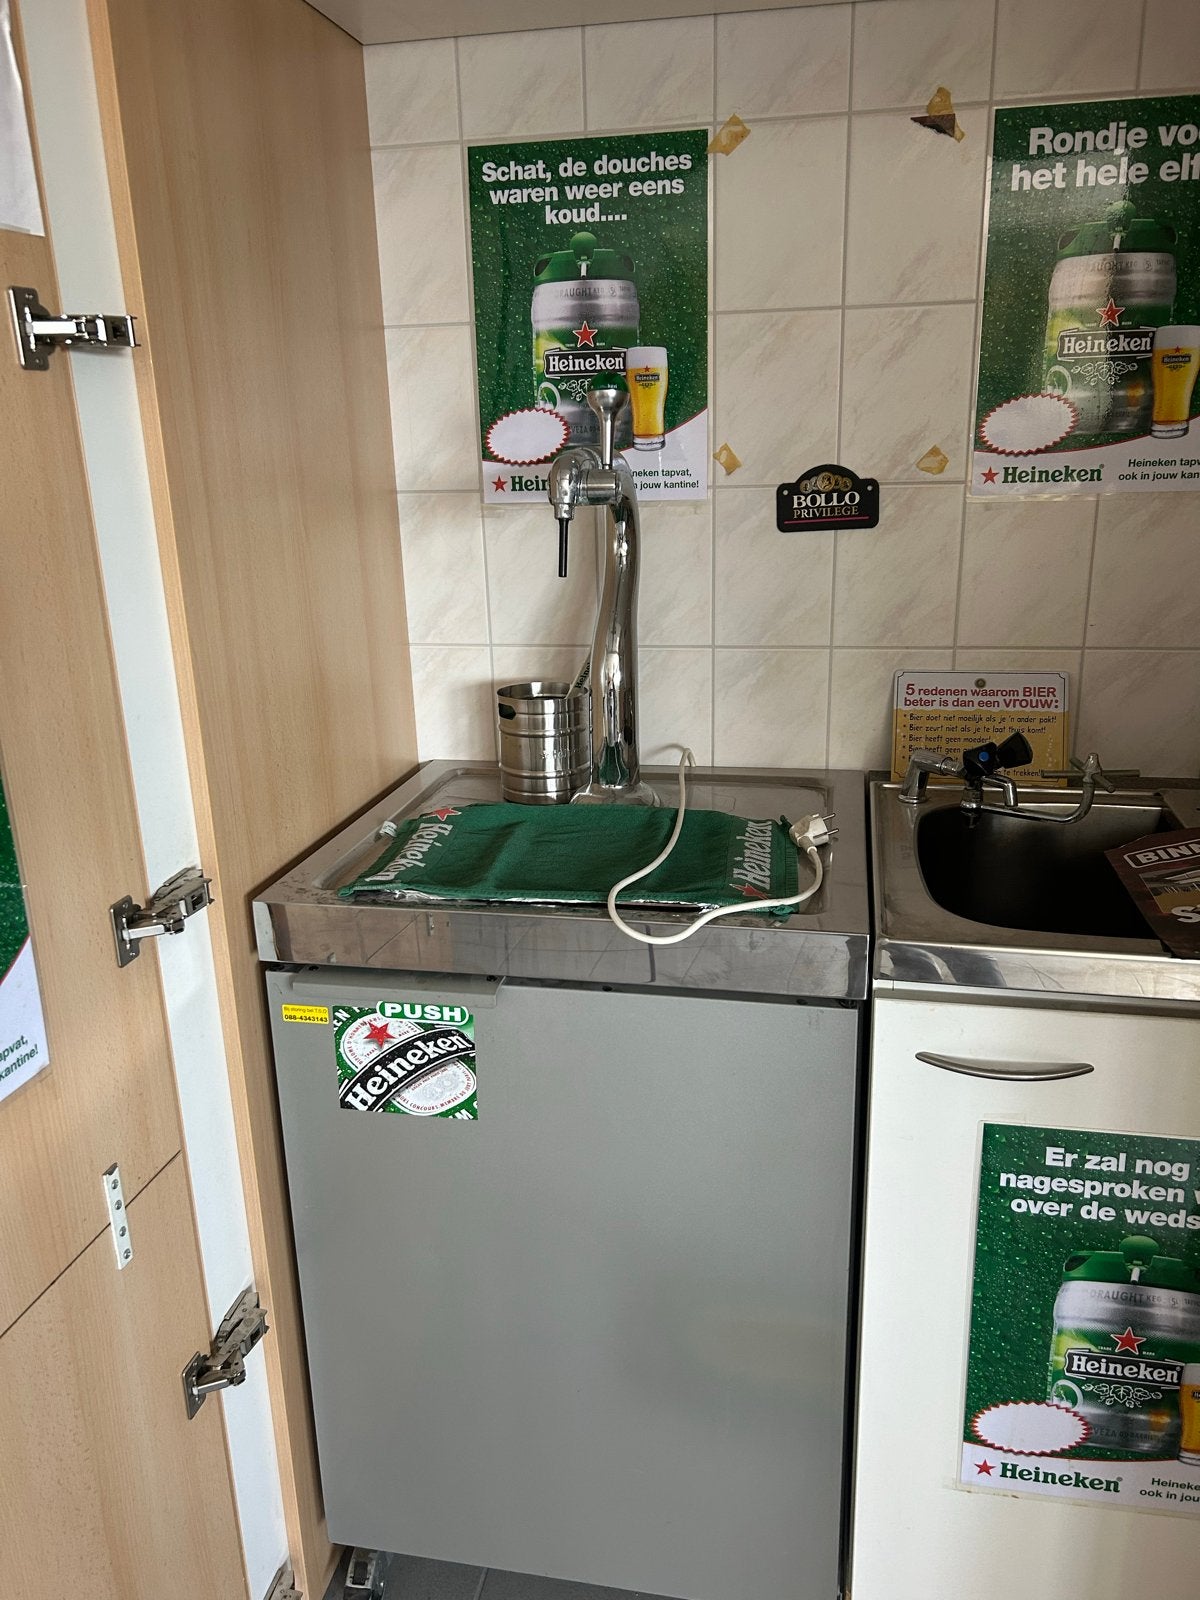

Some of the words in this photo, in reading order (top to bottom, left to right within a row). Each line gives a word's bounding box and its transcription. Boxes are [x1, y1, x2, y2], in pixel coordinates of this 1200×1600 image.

[1028, 122, 1148, 155] Rondje
[1158, 124, 1200, 146] vo
[482, 160, 551, 182] Schat,
[559, 157, 587, 178] de
[593, 151, 692, 176] douches
[1011, 162, 1066, 191] het
[1075, 157, 1149, 187] hele
[489, 185, 558, 205] waren
[565, 181, 622, 201] weer
[628, 178, 684, 197] eens
[545, 202, 627, 224] koud....
[1062, 334, 1151, 355] Heineken
[549, 353, 624, 372] Heineken
[1128, 458, 1176, 468] Heineken
[632, 468, 659, 477] neken
[662, 468, 692, 478] tapvat,
[1002, 466, 1102, 484] Heineken
[1118, 472, 1138, 480] ook
[1140, 472, 1150, 480] in
[1152, 471, 1178, 482] jouw
[510, 476, 550, 492] Hein
[640, 481, 662, 490] jouw
[664, 480, 700, 489] kantine!
[792, 491, 860, 508] BOLLO
[794, 506, 860, 519] PRIVILEGE
[906, 684, 915, 696] 5
[918, 686, 968, 696] redenen
[970, 688, 1020, 697] waarom
[1022, 686, 1056, 698] BIER
[904, 697, 936, 707] beter
[939, 698, 948, 707] is
[952, 698, 974, 708] dan
[978, 700, 1000, 708] een
[998, 716, 1006, 724] je
[908, 734, 922, 742] Bier
[925, 734, 942, 742] heeft
[945, 736, 960, 744] geen
[972, 726, 980, 734] je
[944, 747, 960, 755] geen
[365, 822, 454, 882] Heineken
[732, 820, 772, 890] Heineken
[384, 1002, 462, 1022] PUSH
[345, 1034, 472, 1112] Heineken
[1045, 1146, 1078, 1168] Er
[1084, 1152, 1127, 1172] zal
[1134, 1160, 1190, 1182] nog
[1000, 1172, 1185, 1203] nagesproken
[1010, 1198, 1074, 1217] over
[1080, 1200, 1117, 1222] de
[1071, 1354, 1180, 1384] Heineken
[1000, 1462, 1120, 1493] Heineken
[1140, 1490, 1162, 1498] ook
[1166, 1490, 1177, 1500] in
